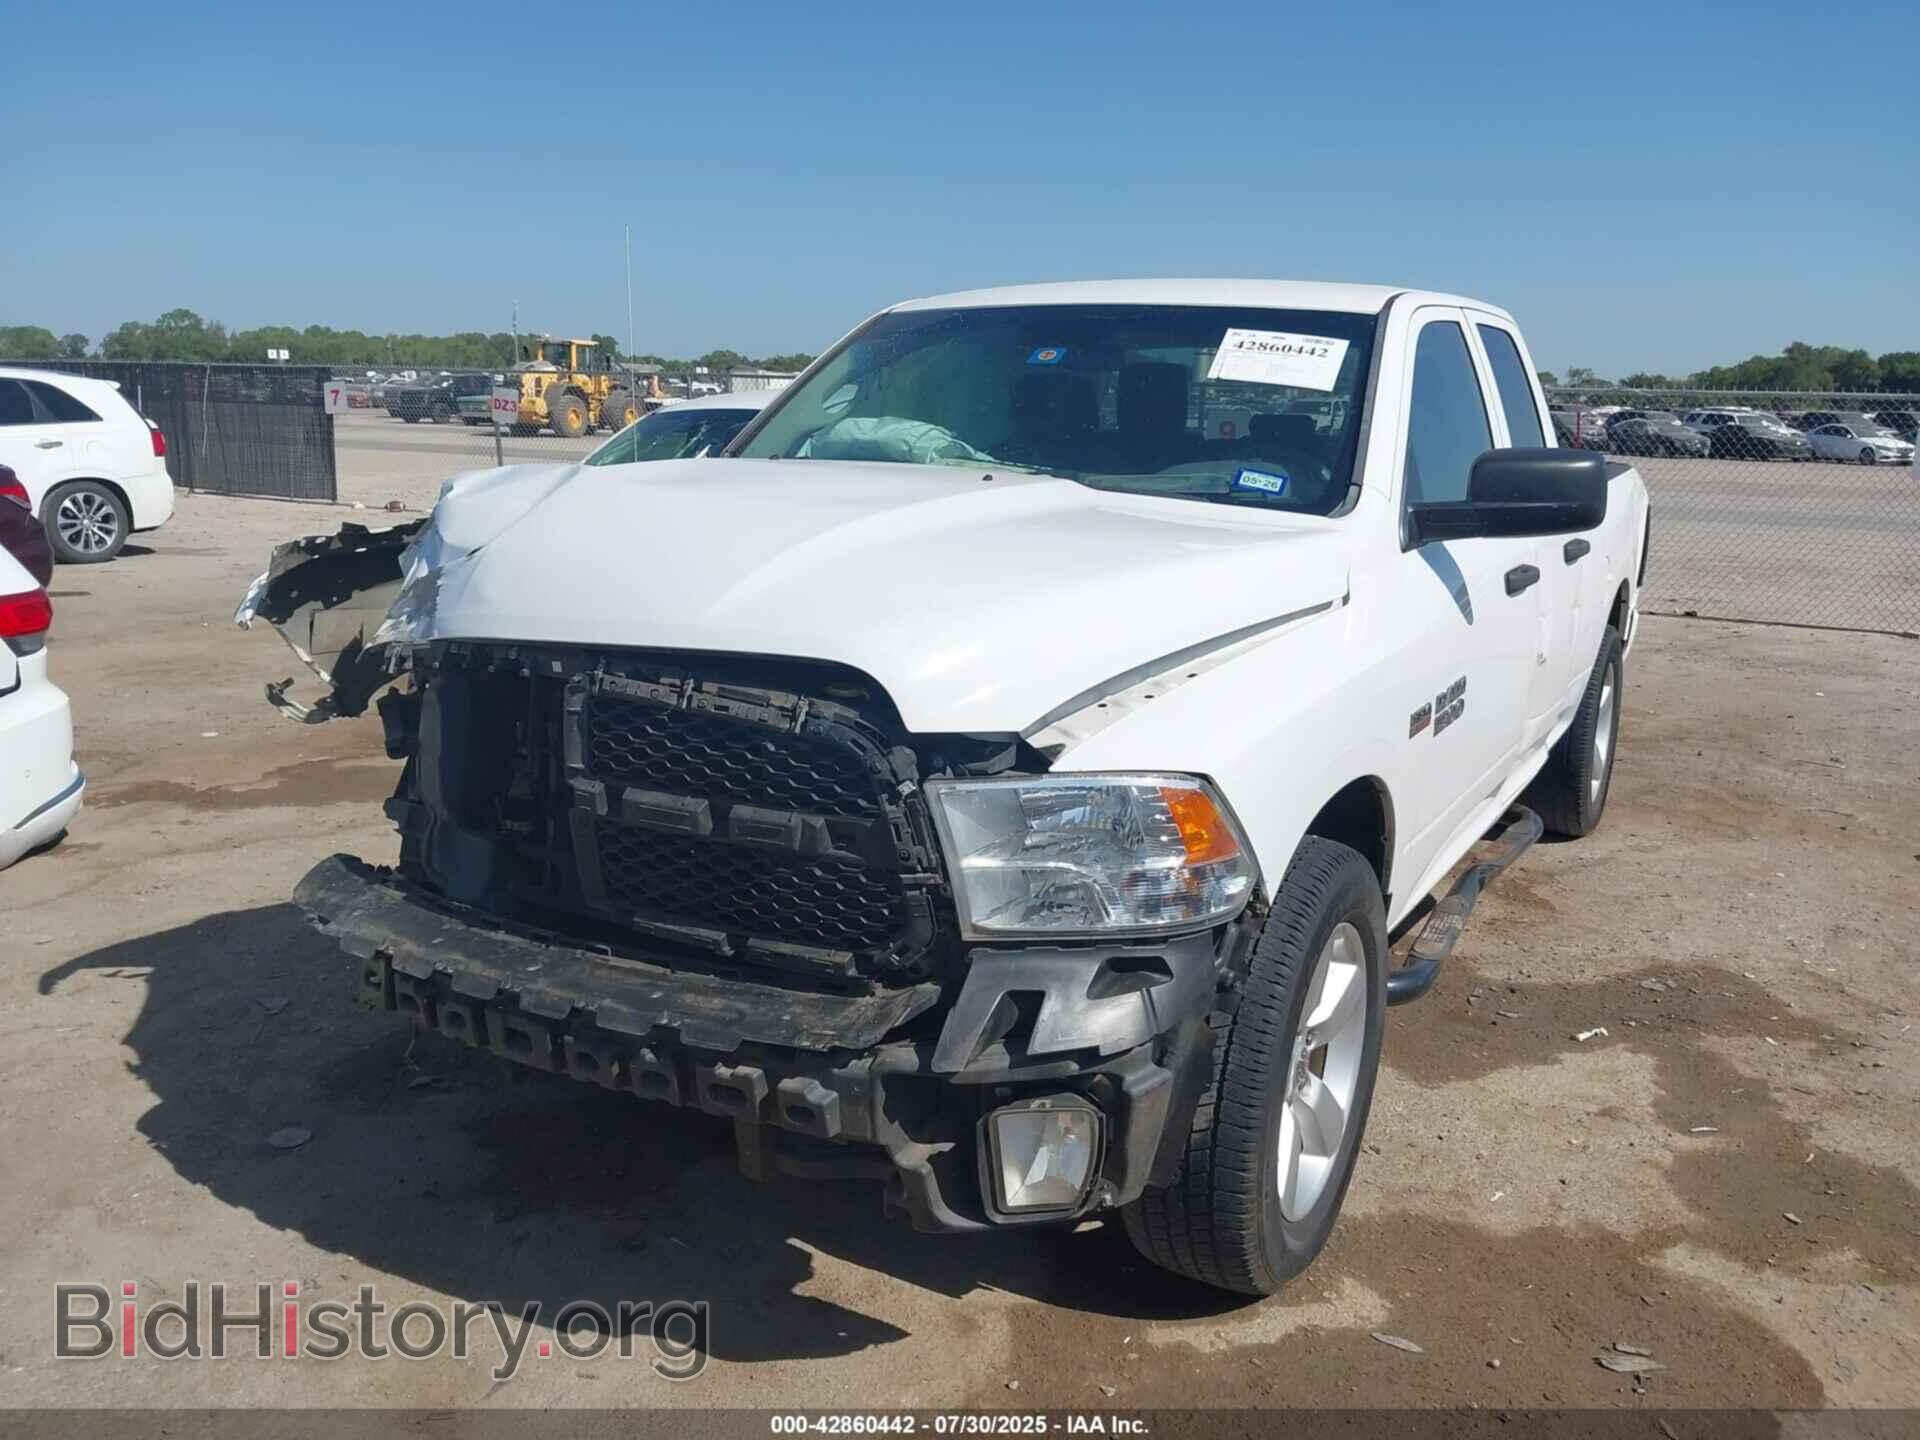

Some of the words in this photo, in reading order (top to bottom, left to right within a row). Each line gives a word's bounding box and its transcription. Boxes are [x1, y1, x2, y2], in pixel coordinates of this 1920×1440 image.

[1233, 340, 1329, 358] 42860442
[330, 390, 340, 406] 7
[494, 398, 517, 412] DZ3
